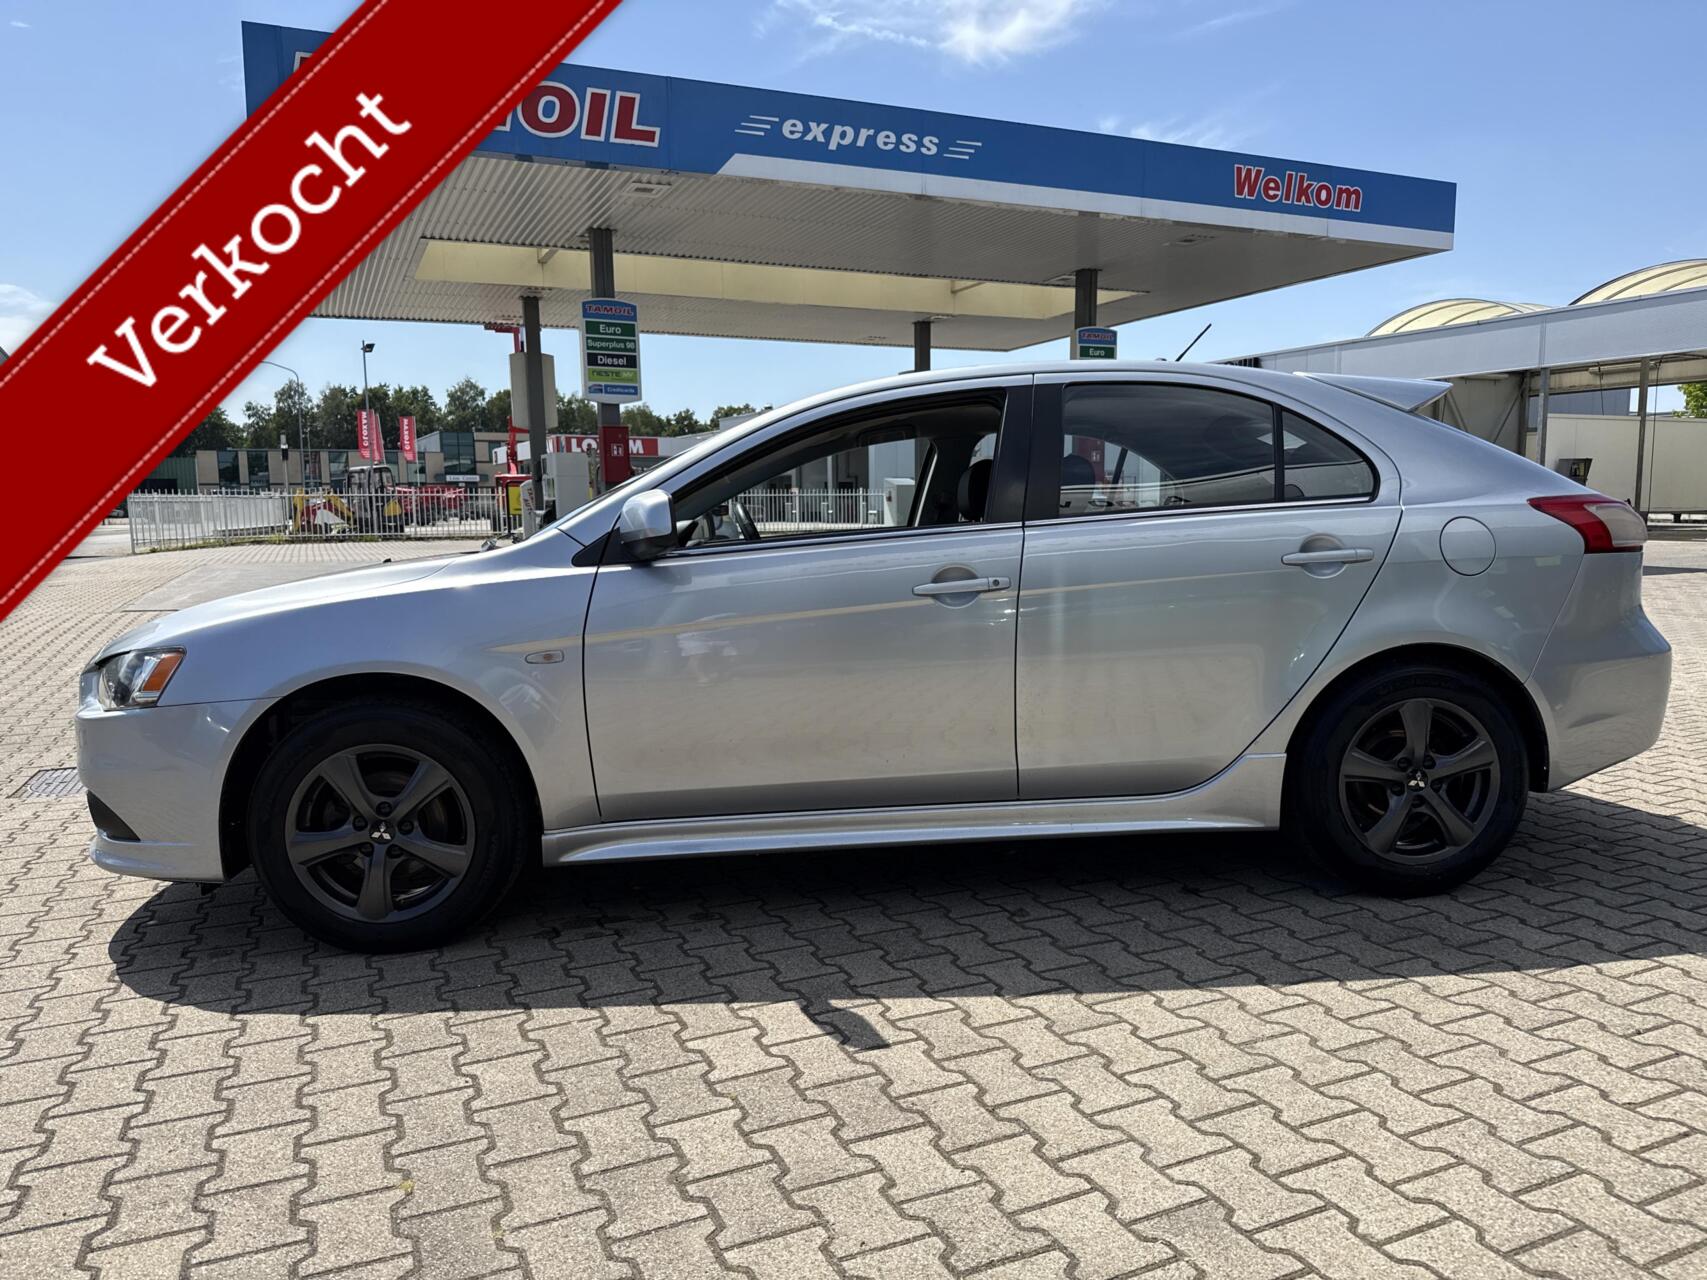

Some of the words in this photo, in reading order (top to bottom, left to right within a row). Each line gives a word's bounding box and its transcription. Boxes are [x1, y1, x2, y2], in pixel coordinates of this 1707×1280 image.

[781, 118, 939, 156] express
[1234, 164, 1363, 212] Welkom
[586, 304, 634, 316] TAMOIL
[600, 324, 621, 334] Euro
[588, 339, 624, 349] Superplus
[1089, 348, 1105, 356] Euro
[597, 355, 627, 365] Diesel
[571, 438, 644, 454] LOM
